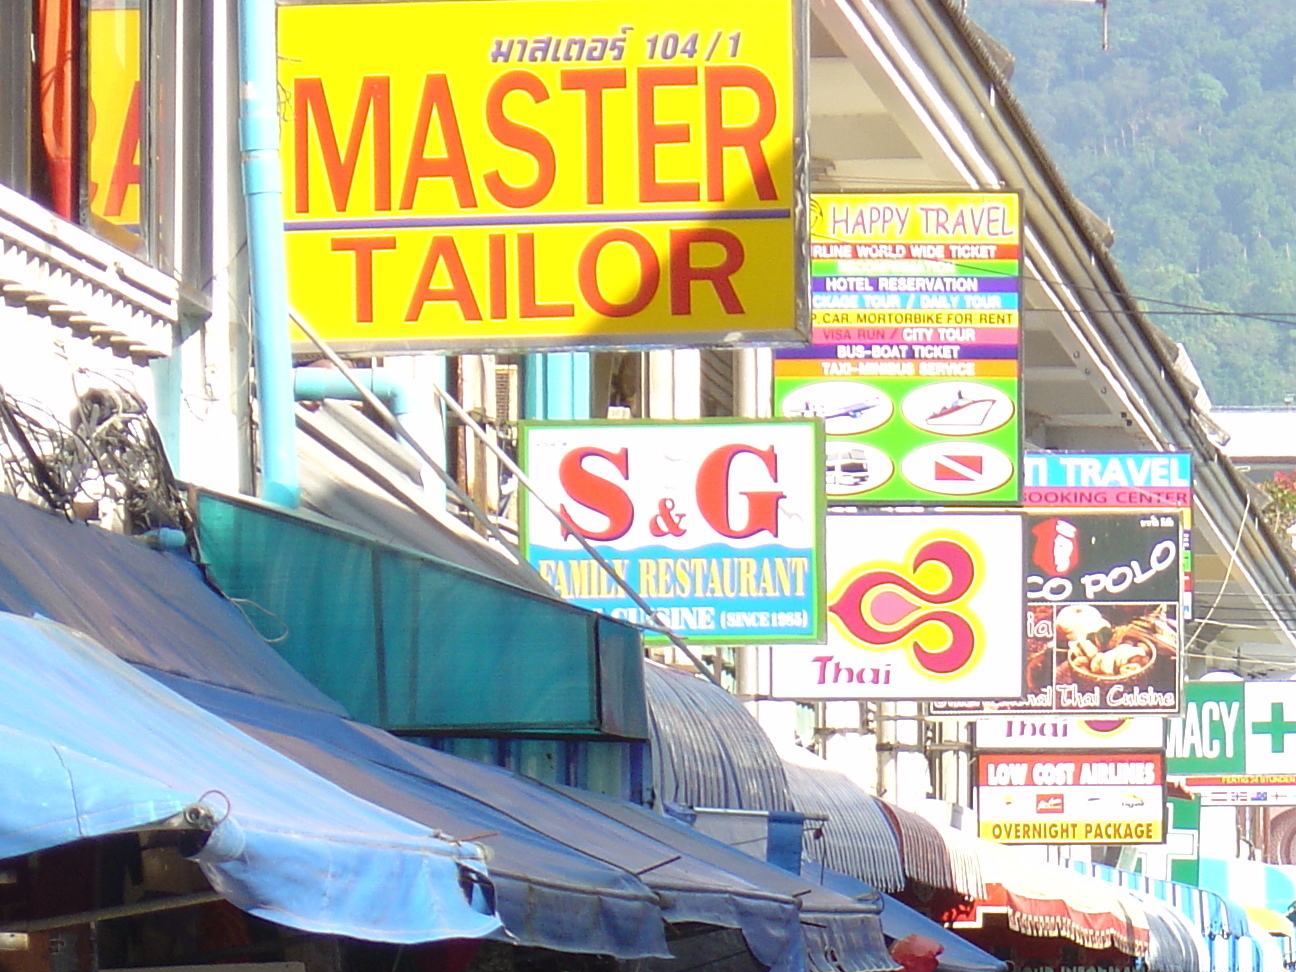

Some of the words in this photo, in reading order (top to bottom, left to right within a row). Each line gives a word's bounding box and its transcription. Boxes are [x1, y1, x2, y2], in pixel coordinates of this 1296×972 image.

[490, 26, 635, 63] มาสเตอร์
[294, 65, 778, 214] MASTER
[832, 206, 909, 235] HAPPY
[920, 205, 1014, 236] TRAVEL
[856, 245, 907, 259] WORLD
[910, 245, 945, 258] WIDE
[950, 245, 997, 258] TICKET
[330, 228, 747, 324] TAILOR
[825, 278, 873, 291] HOTEL
[878, 278, 978, 291] RESERVATION
[863, 295, 901, 308] TOUR
[920, 295, 960, 308] DAILY
[963, 295, 1001, 308] TOUR
[856, 313, 943, 324] MORTORBIKE
[947, 313, 973, 324] FOR
[979, 313, 1014, 324] RENT
[824, 329, 851, 340] VISA
[857, 329, 885, 340] RUN
[902, 328, 934, 341] CITY
[938, 328, 976, 341] TOUR
[837, 346, 908, 359] BUS-BOAT
[912, 346, 960, 359] TICKET
[918, 363, 976, 376] SERVICE
[1060, 456, 1189, 487] TRAVEL
[558, 445, 635, 543] S
[648, 497, 687, 538] &
[694, 443, 788, 540] G
[1024, 491, 1108, 504] OOKING
[1115, 491, 1188, 505] CENTER
[539, 560, 629, 599] FAMILY
[638, 557, 808, 598] RESTAURANT
[1081, 540, 1176, 600] POLO
[811, 655, 892, 685] Thai
[1056, 684, 1100, 707] Thai
[1106, 684, 1176, 707] Cuisine
[987, 762, 1028, 786] LOW
[1032, 762, 1075, 786] COST
[1079, 762, 1156, 786] AIRLINES
[992, 823, 1078, 840] OVERNIGHT
[1084, 823, 1154, 840] PACKAGE
